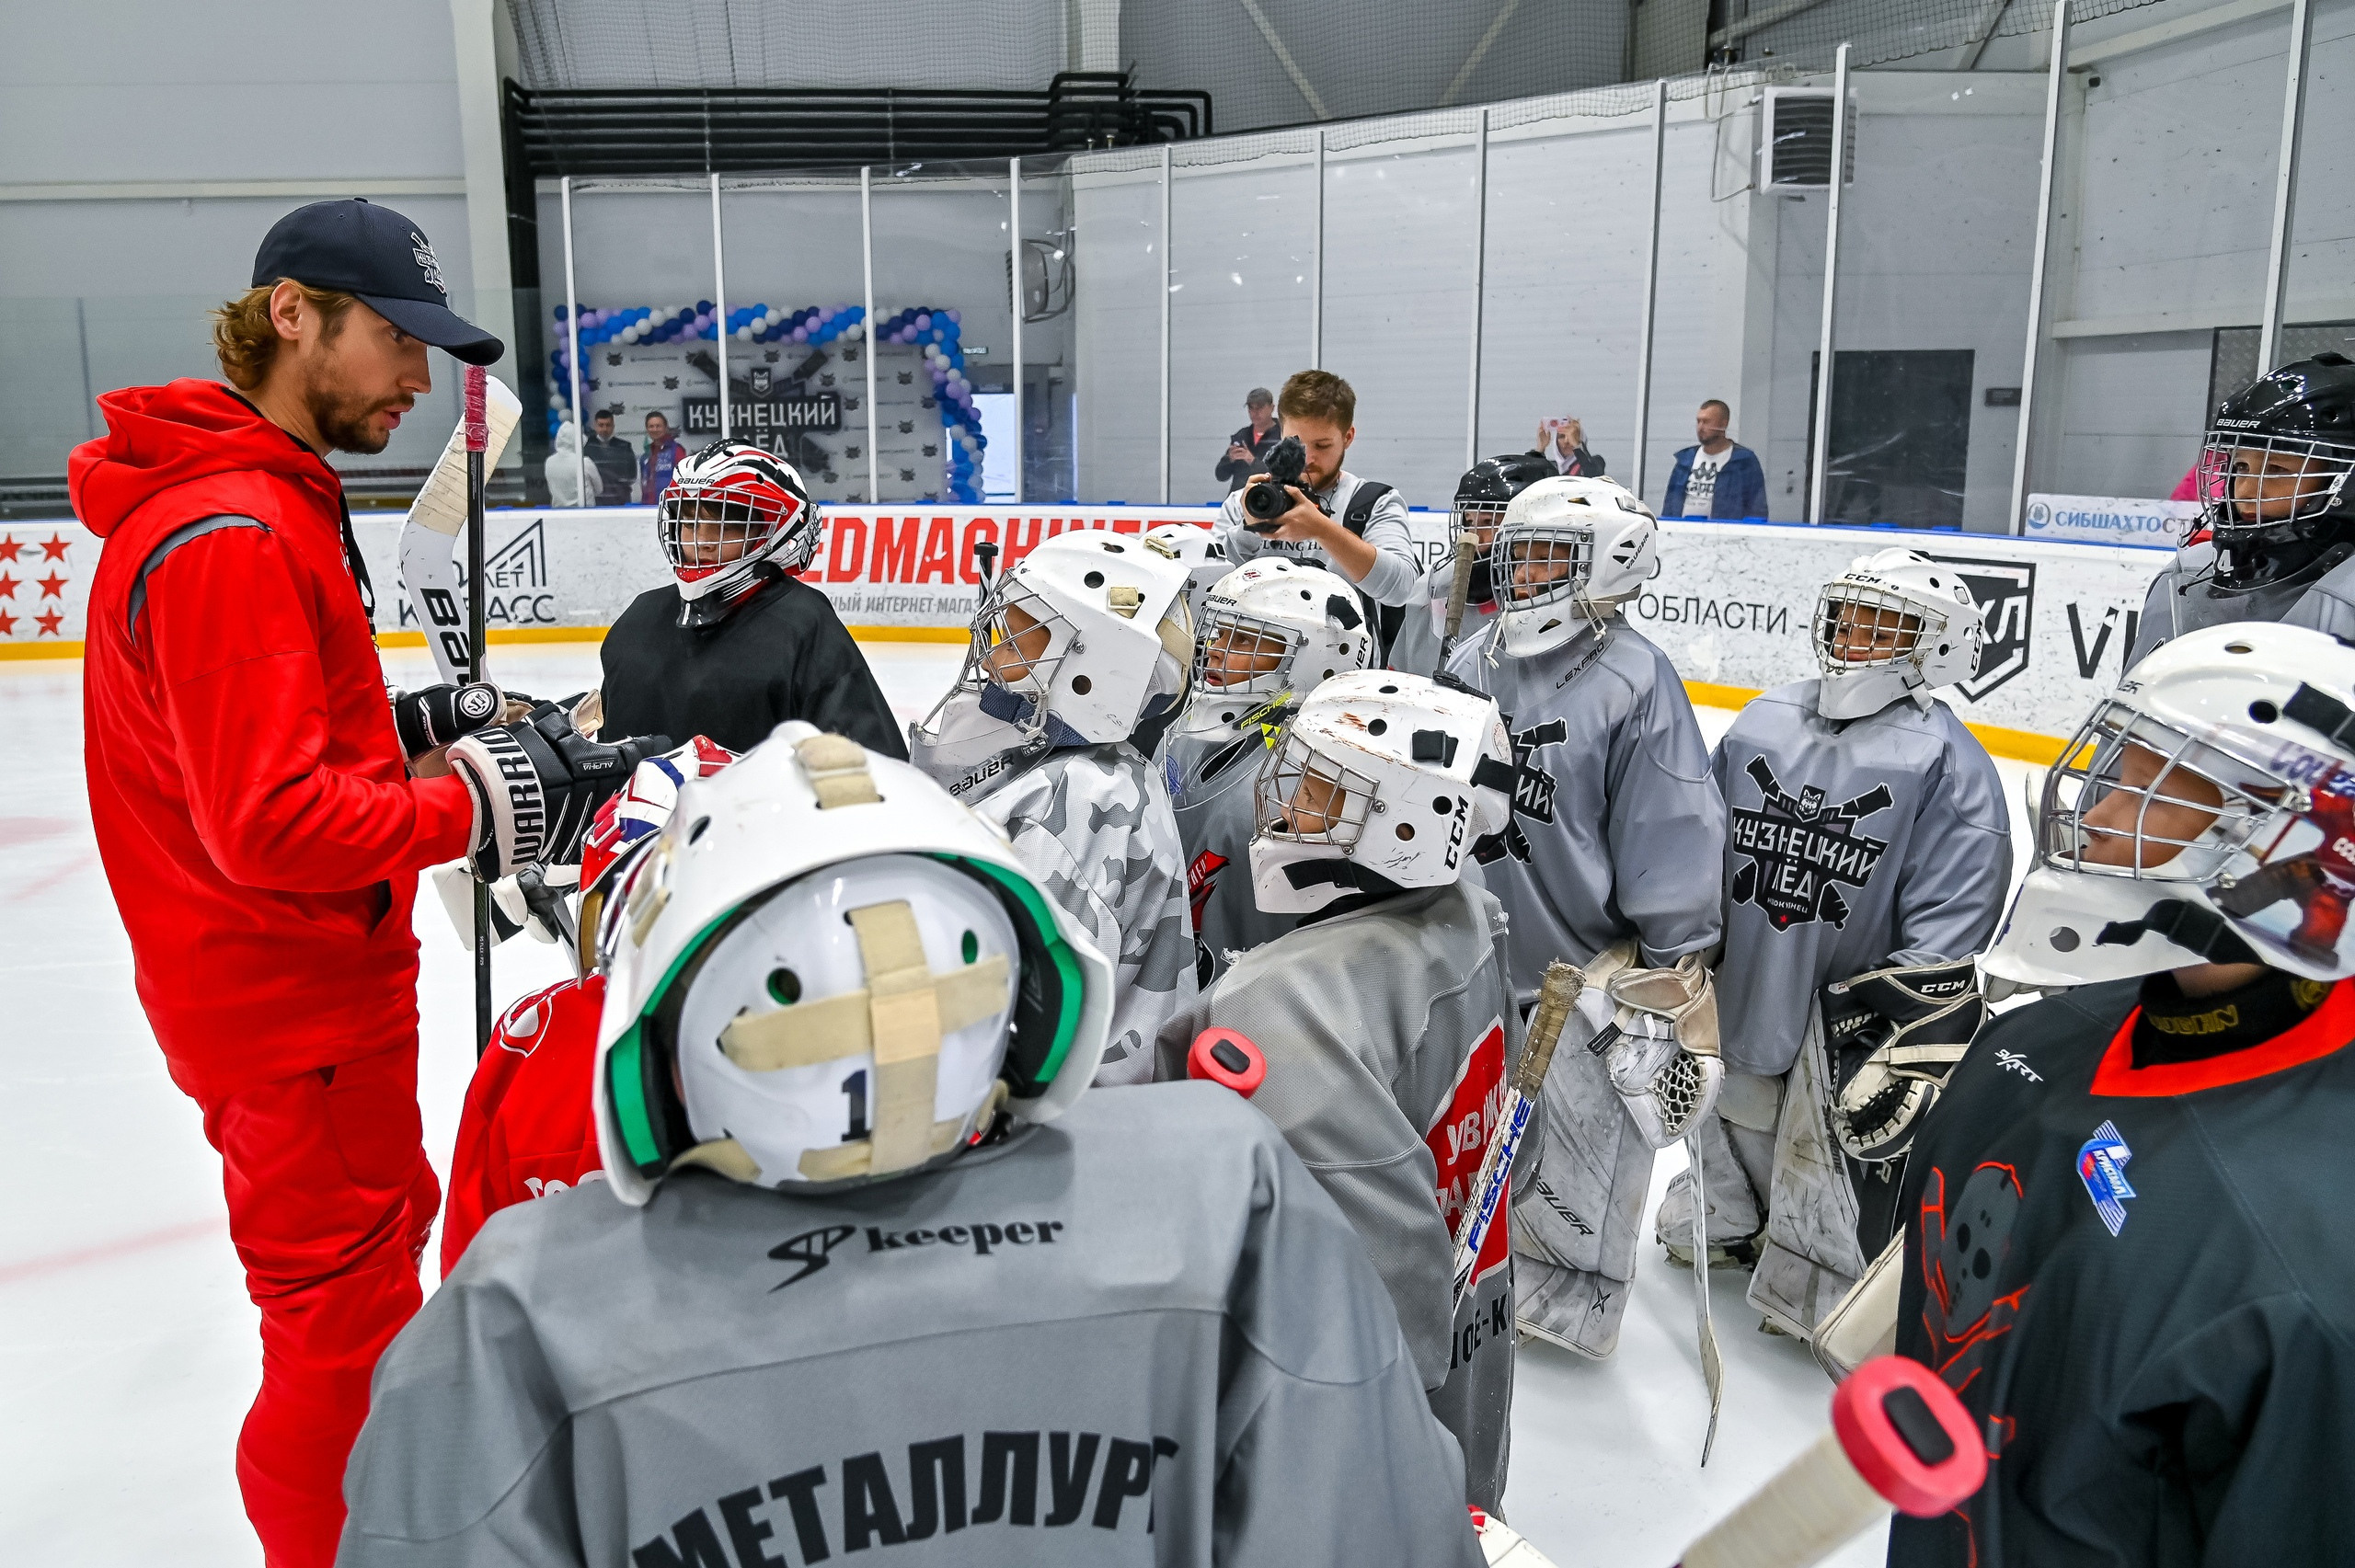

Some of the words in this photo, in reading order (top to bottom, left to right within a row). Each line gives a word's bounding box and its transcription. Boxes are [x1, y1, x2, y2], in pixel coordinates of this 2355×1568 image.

[2216, 418, 2261, 429] BAUER
[2055, 510, 2196, 533] СИБШАХТОСТ
[1844, 572, 1882, 585] CCM
[2217, 549, 2234, 578] 4
[1637, 593, 1787, 635] ОБЛАСТИ
[1555, 641, 1605, 691] LEXPRO
[1240, 691, 1292, 731] FISCHER
[582, 761, 615, 771] ALPHA
[1444, 795, 1469, 871] CCM
[1733, 817, 1882, 879] КУЗНЕЦКИЙ
[1920, 979, 1966, 993] CCM
[840, 1068, 872, 1142] 1
[1467, 1095, 1532, 1254] FISCHE
[1453, 1181, 1479, 1252] FISCHE
[1535, 1176, 1595, 1237] AUER
[867, 1219, 1064, 1255] keeper
